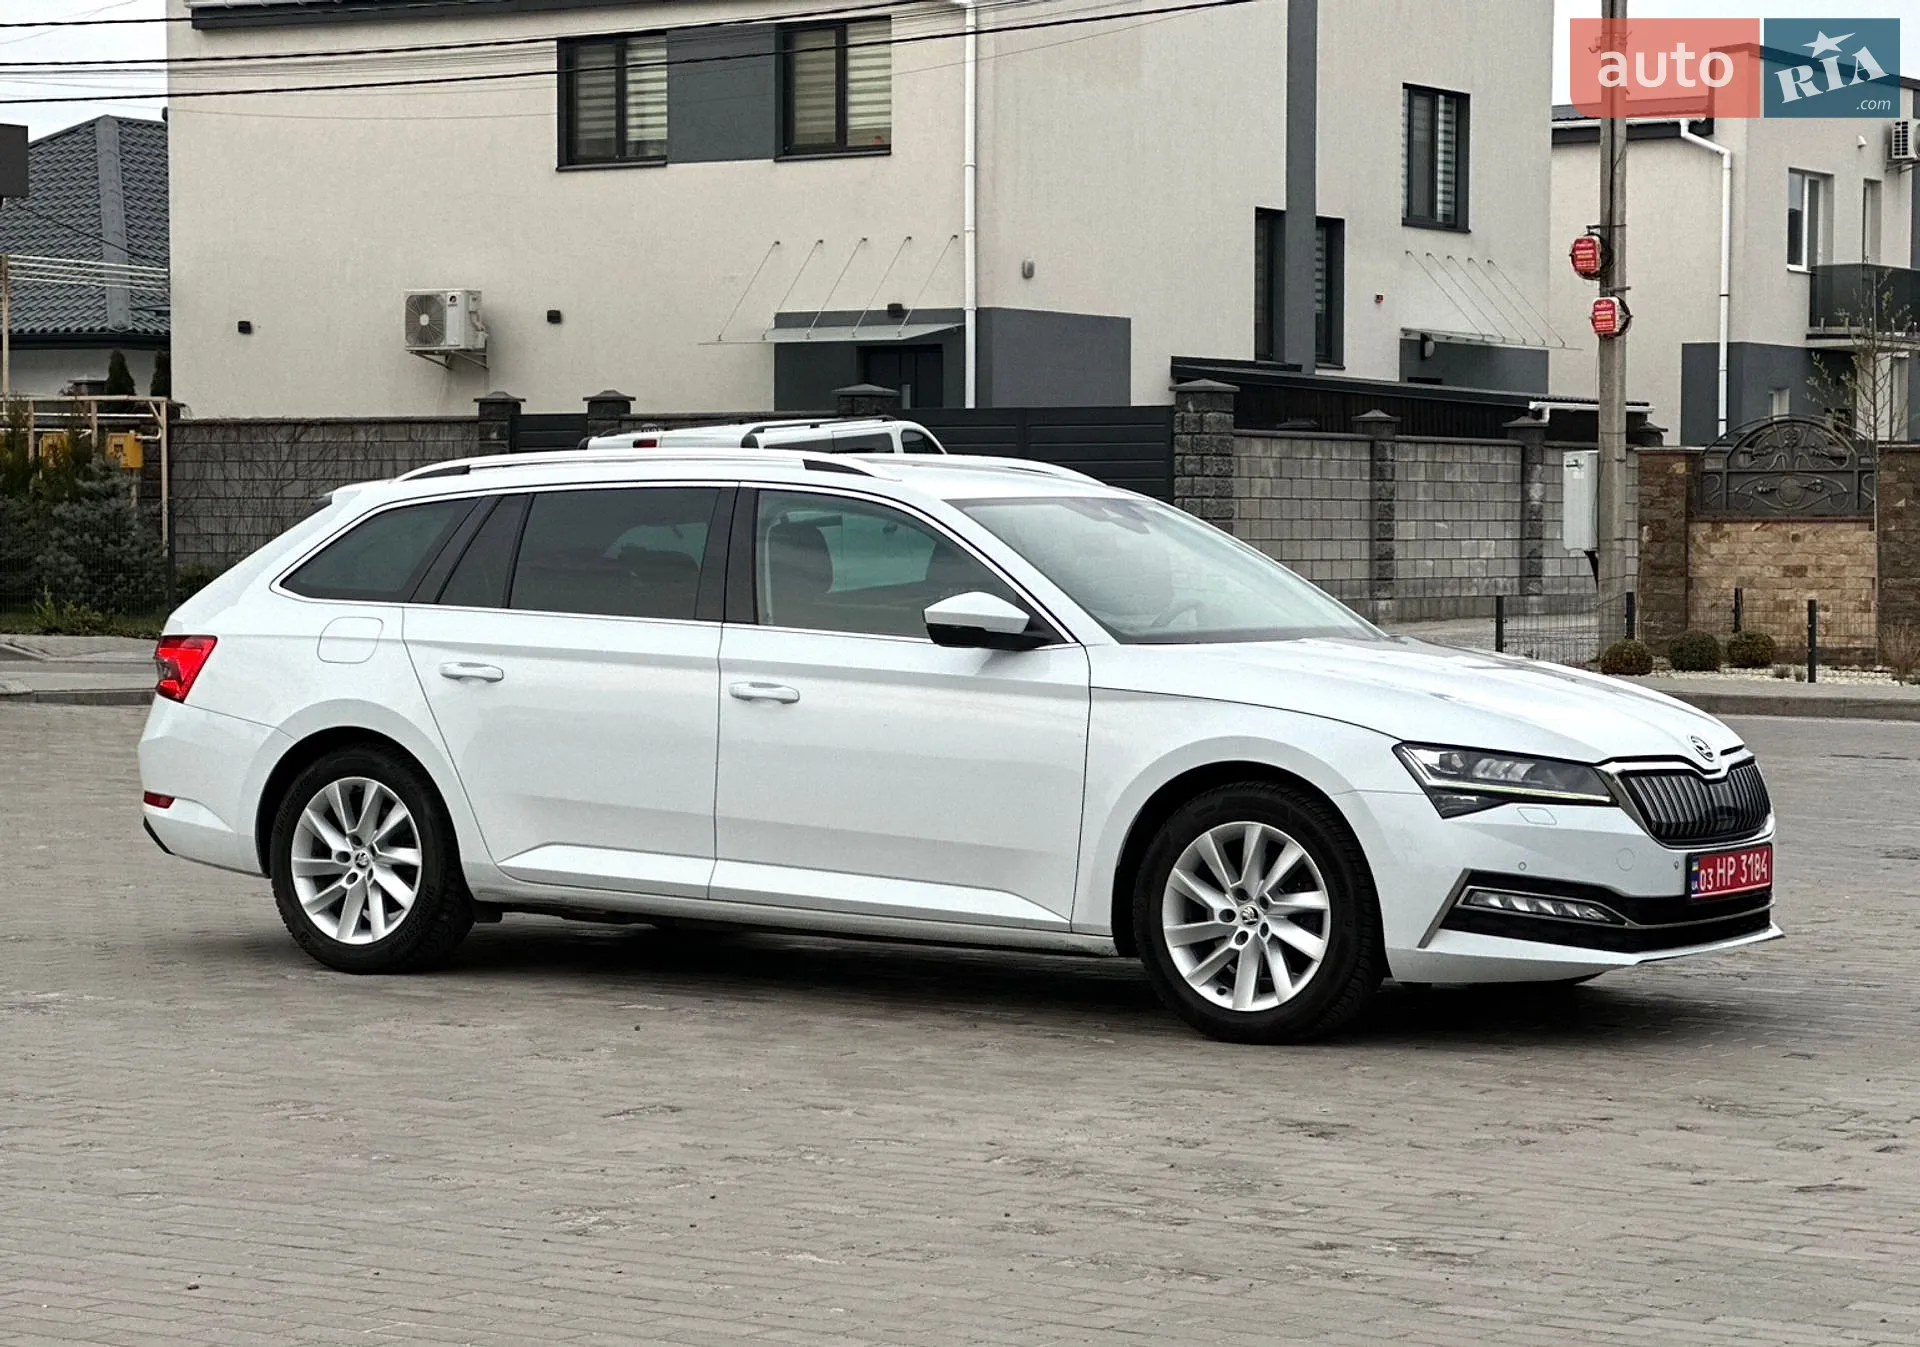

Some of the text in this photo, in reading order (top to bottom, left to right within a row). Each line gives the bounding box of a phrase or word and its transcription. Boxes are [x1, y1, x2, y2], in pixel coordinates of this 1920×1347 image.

[1700, 851, 1768, 891] 03 HP 3184
